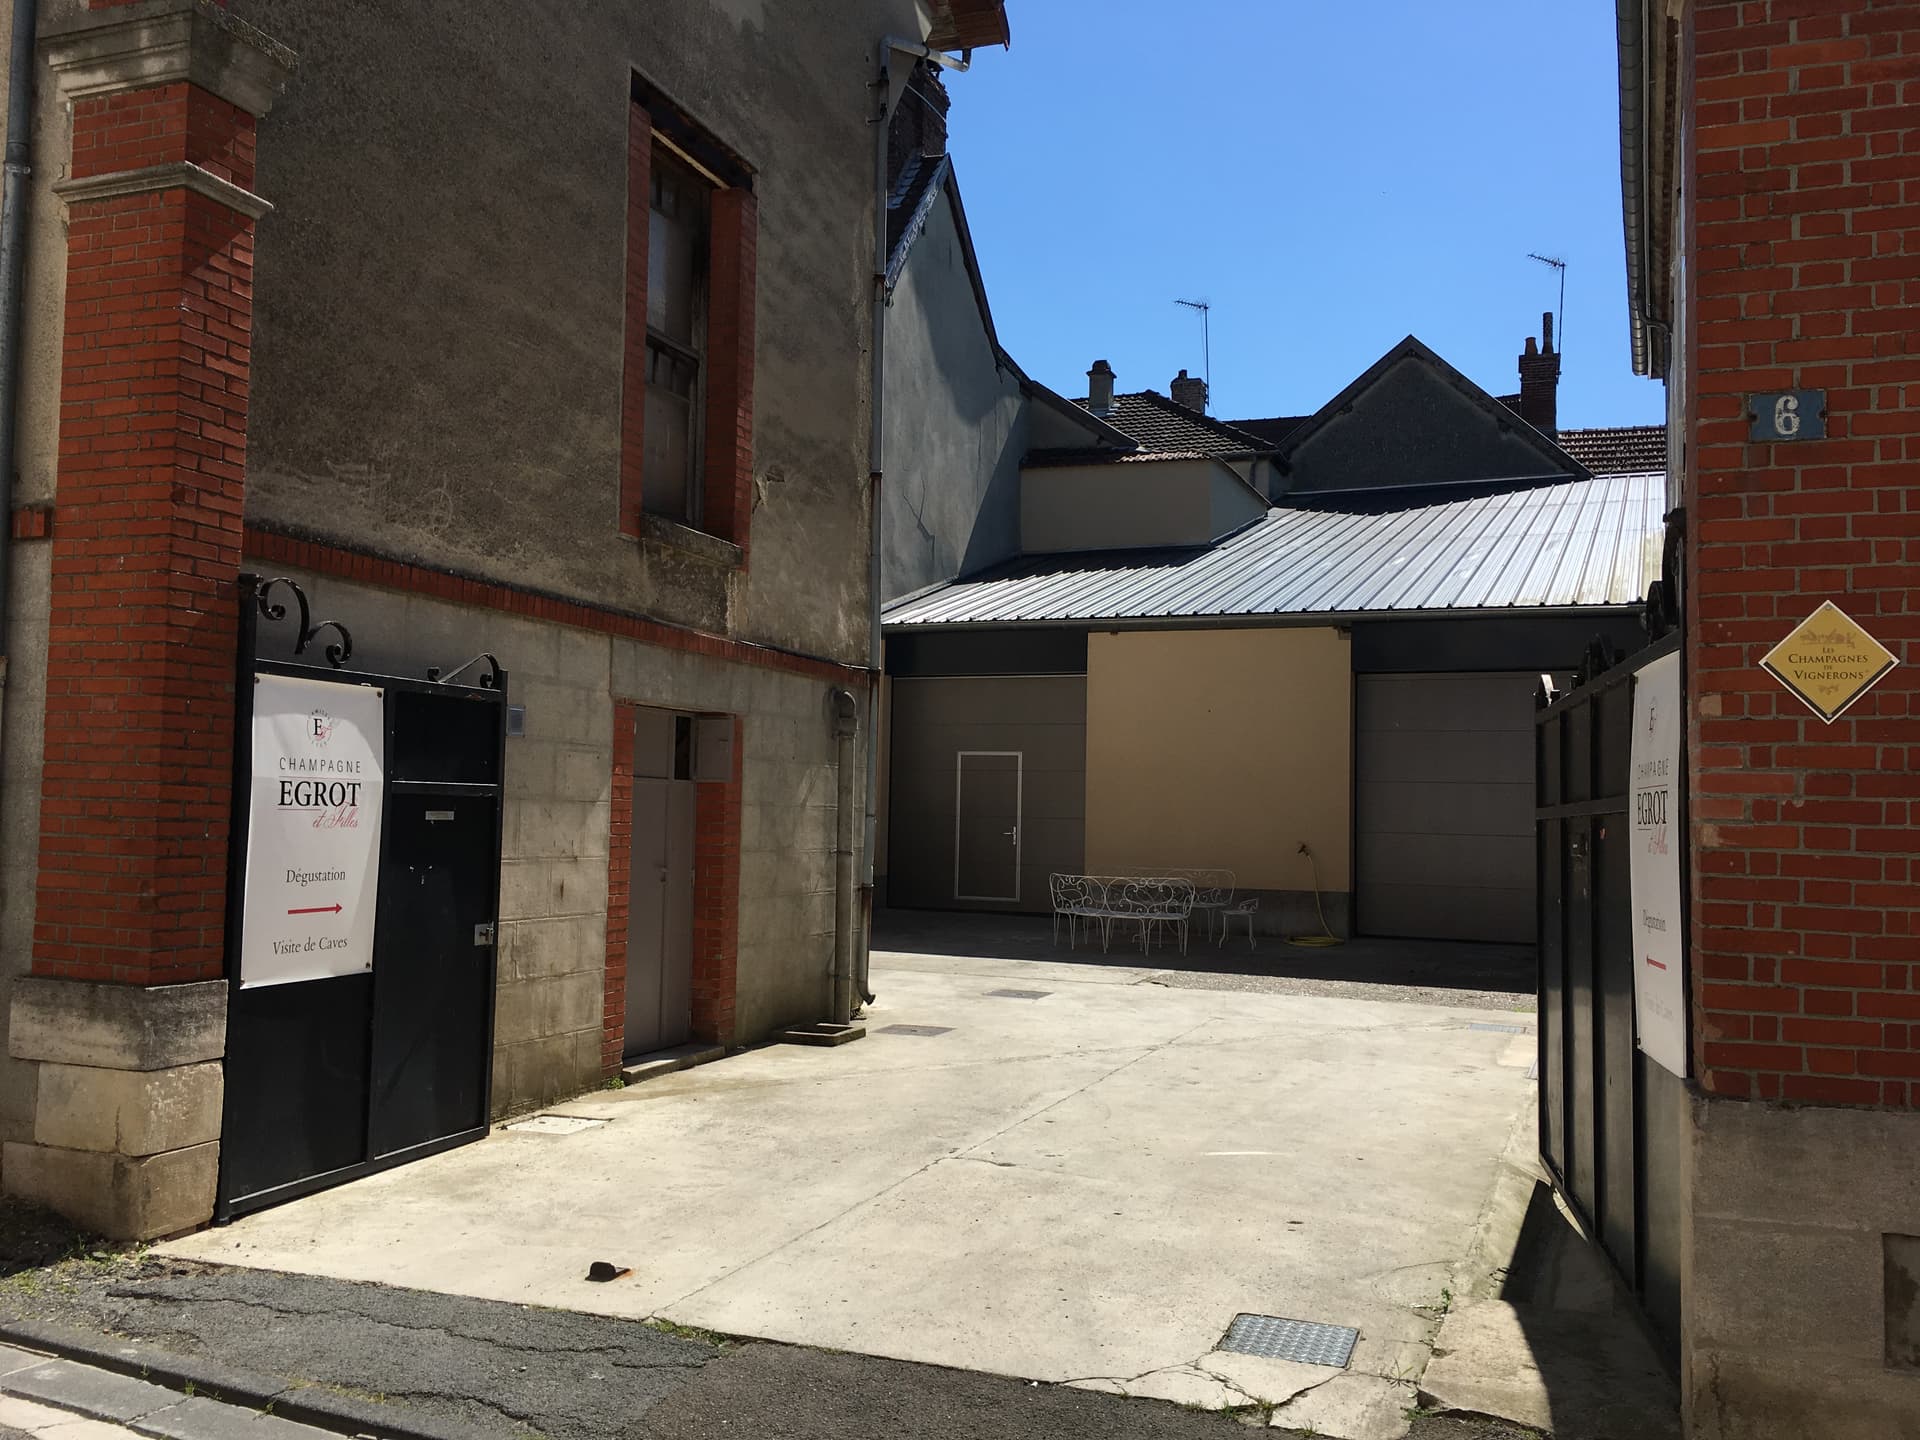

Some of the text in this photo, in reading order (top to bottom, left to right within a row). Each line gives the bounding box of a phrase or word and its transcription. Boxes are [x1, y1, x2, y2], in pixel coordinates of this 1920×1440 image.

[1775, 395, 1800, 435] 6
[1788, 653, 1869, 664] CHAMPAGNES
[1794, 670, 1864, 680] VIGNERONS
[279, 756, 361, 774] CHAMPAGNE
[277, 780, 361, 807] EGROT
[1637, 790, 1668, 825] EGROT
[286, 867, 346, 888] Dégustation
[273, 936, 348, 955] Visite de Caves
